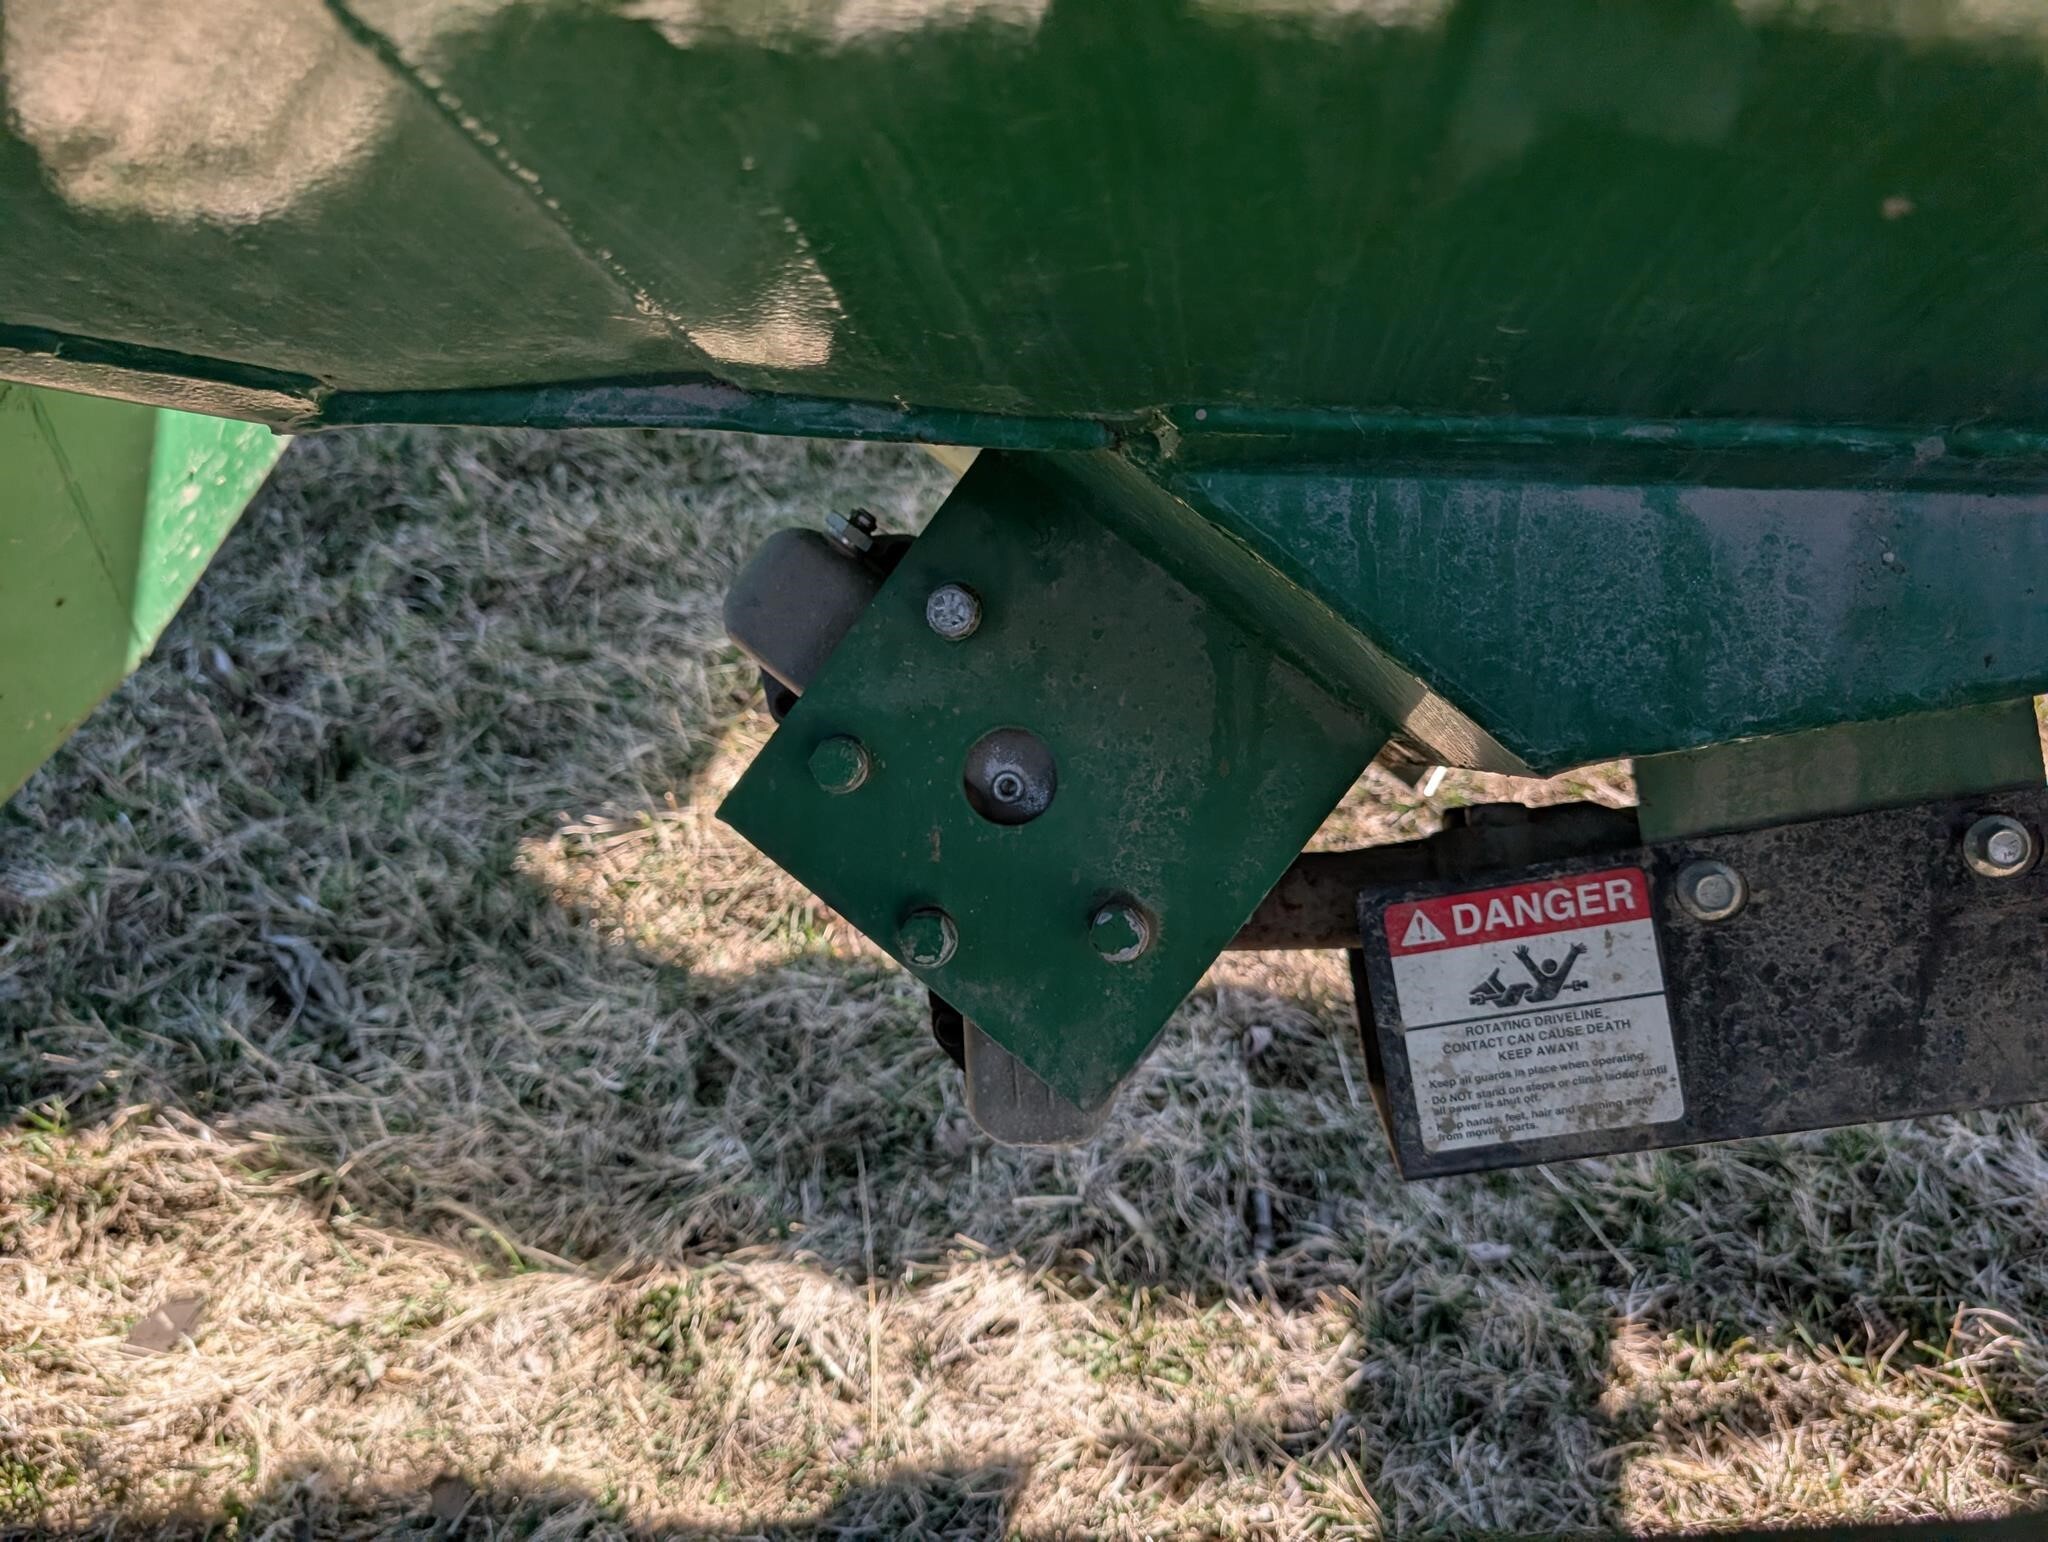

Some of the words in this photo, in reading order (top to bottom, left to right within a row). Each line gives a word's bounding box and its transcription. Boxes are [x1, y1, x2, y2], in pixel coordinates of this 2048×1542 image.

[1451, 878, 1636, 936] DANGER
[1442, 1037, 1504, 1055] CONTACT
[1507, 1032, 1535, 1046] CAN
[1538, 1025, 1583, 1041] CAUSE
[1587, 1019, 1631, 1035] DEATH
[1465, 1018, 1531, 1037] ROTATING
[1498, 1047, 1533, 1061] KEEP
[1536, 1041, 1579, 1056] AWAY!
[1429, 1079, 1456, 1090] Keep
[1460, 1075, 1471, 1085] all
[1474, 1070, 1512, 1084] guards
[1515, 1066, 1525, 1077] in
[1528, 1065, 1558, 1078] place
[1559, 1059, 1589, 1071] when
[1432, 1096, 1446, 1105] Do
[1450, 1091, 1472, 1102] NOT
[1476, 1087, 1505, 1099] stand
[1509, 1086, 1522, 1096] on
[1526, 1081, 1557, 1093] steps
[1558, 1079, 1569, 1088] or
[1643, 1064, 1667, 1077] until
[1484, 1099, 1494, 1109] is
[1497, 1096, 1521, 1108] shut
[1437, 1120, 1464, 1133] Kp
[1531, 1107, 1553, 1119] hair
[1555, 1105, 1575, 1116] and
